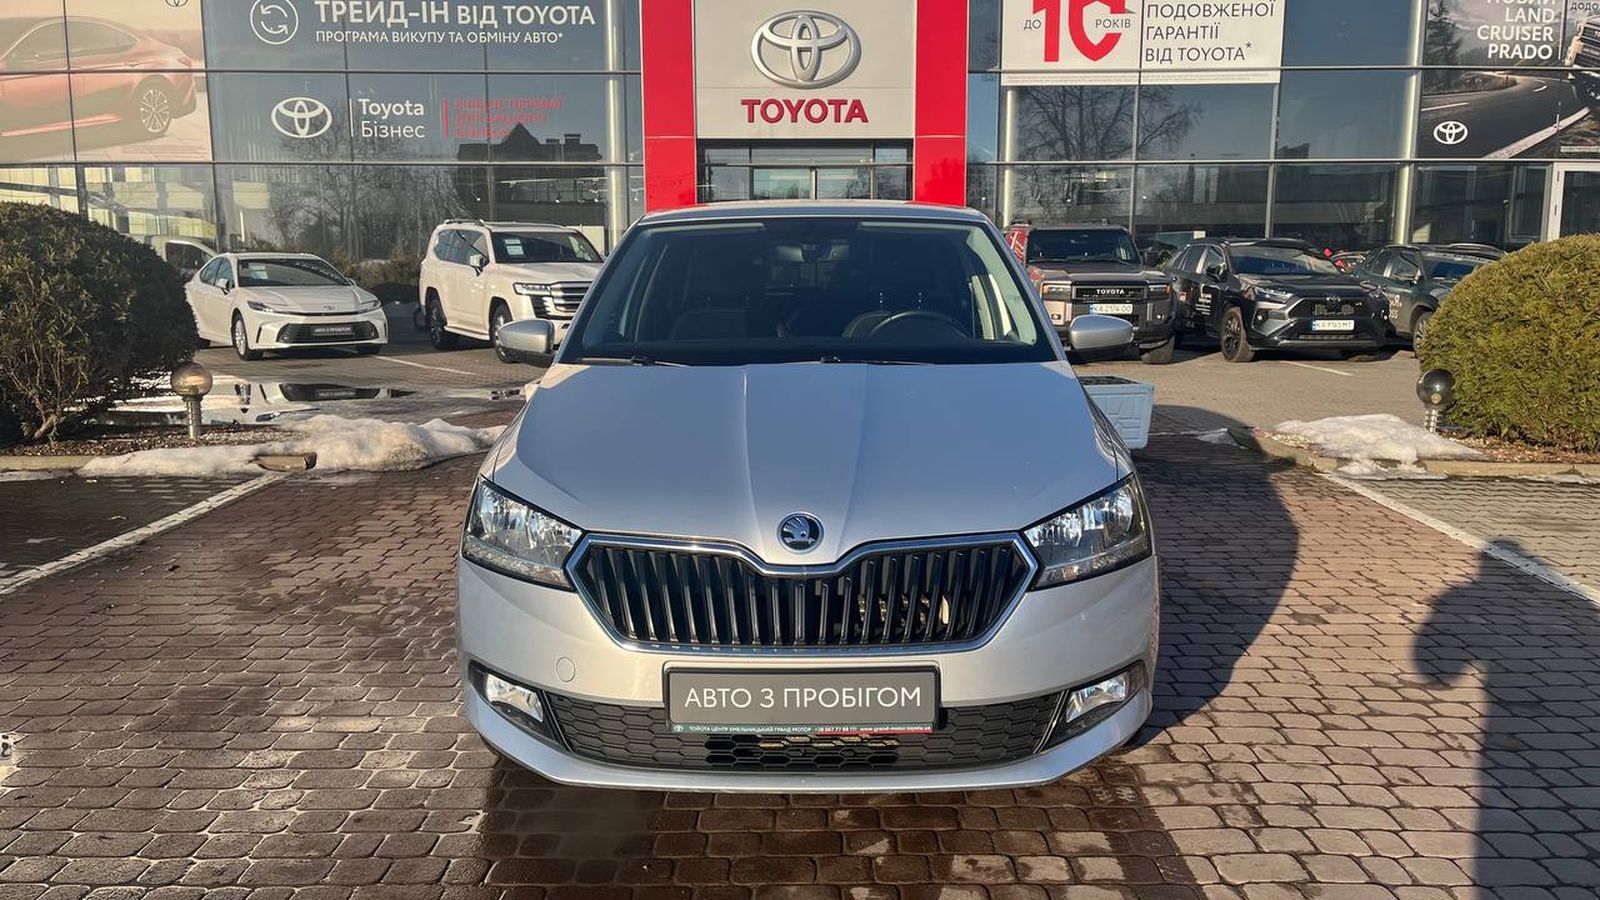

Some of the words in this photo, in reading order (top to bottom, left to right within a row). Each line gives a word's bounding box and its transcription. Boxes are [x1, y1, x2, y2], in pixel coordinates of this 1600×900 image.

[314, 0, 449, 28] ТРЕЙД-ІН
[457, 5, 498, 29] ВІД
[502, 5, 596, 25] TOYOTA
[1147, 0, 1277, 20] ПОДОВЖЕНОЇ
[1505, 7, 1555, 23] LAND
[1024, 19, 1042, 30] ДО
[1095, 18, 1131, 29] РОКІВ
[1146, 22, 1221, 40] ГАРАНТІЇ
[316, 31, 389, 43] ПРОГРАМА
[392, 31, 446, 43] ВИКУПУ
[448, 31, 464, 43] ТА
[467, 31, 521, 44] ОБМІНУ
[1477, 25, 1554, 42] CRUISER
[1145, 48, 1173, 64] ВІД
[1488, 43, 1553, 60] PRADO
[358, 99, 424, 119] Toyota
[741, 98, 869, 124] TOYOTA
[361, 120, 425, 139] Бізнес
[684, 687, 752, 708] АВТО
[759, 687, 775, 708] З
[783, 686, 921, 708] ПРОБІГОМ
